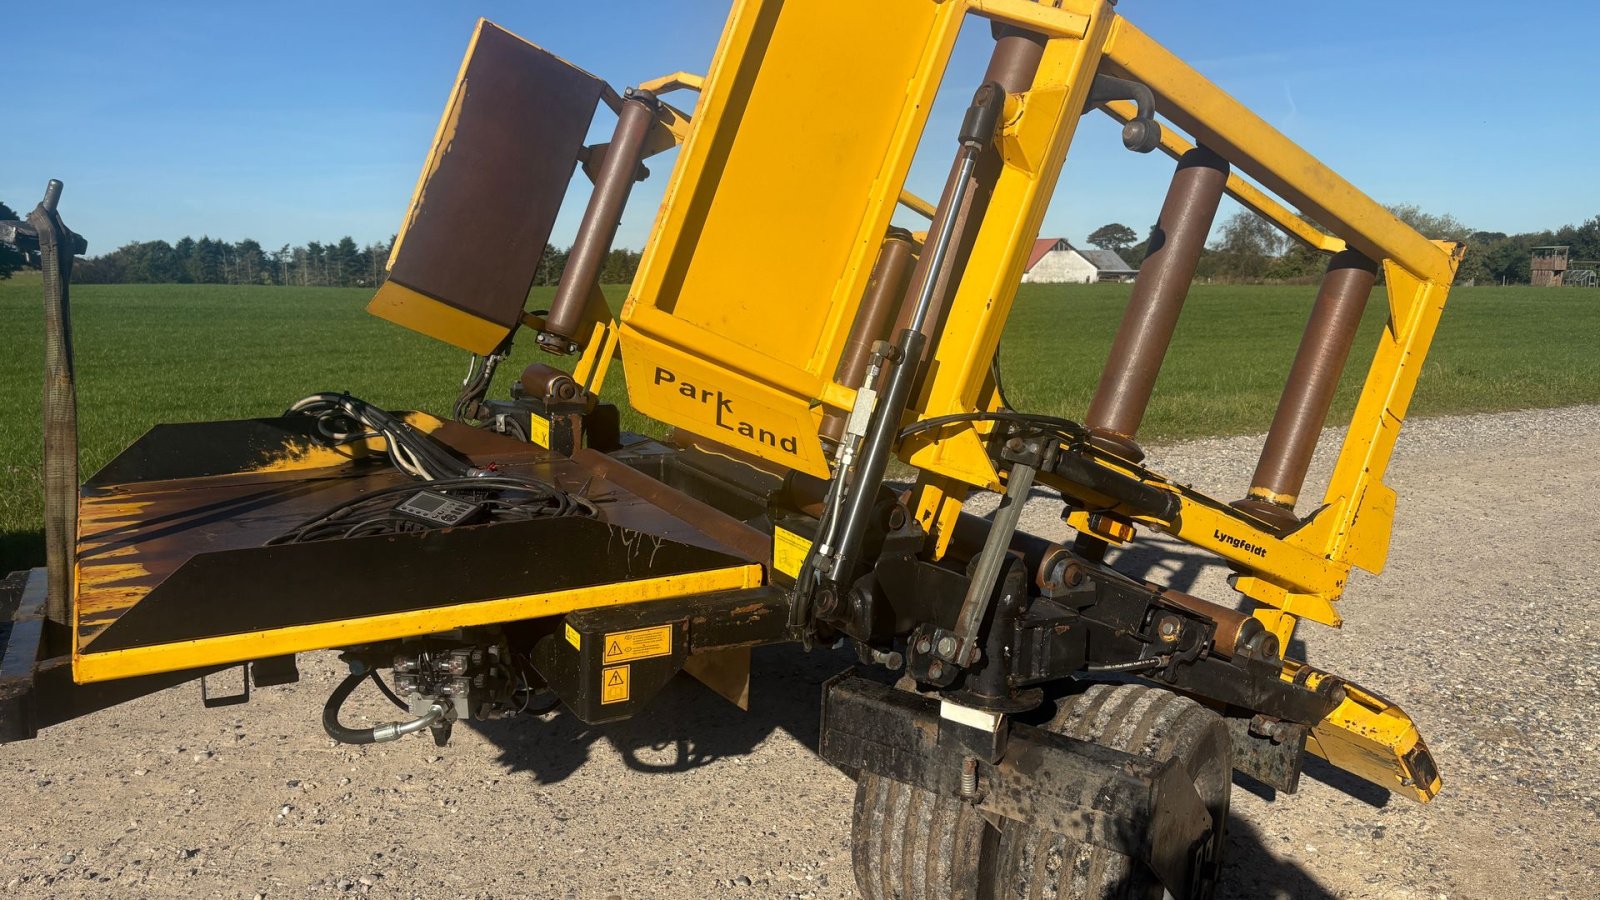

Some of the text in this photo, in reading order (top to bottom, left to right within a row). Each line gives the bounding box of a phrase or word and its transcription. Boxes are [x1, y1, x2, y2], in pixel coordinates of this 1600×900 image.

[654, 366, 798, 455] Park Land
[1213, 529, 1267, 558] Lyngfeldt
